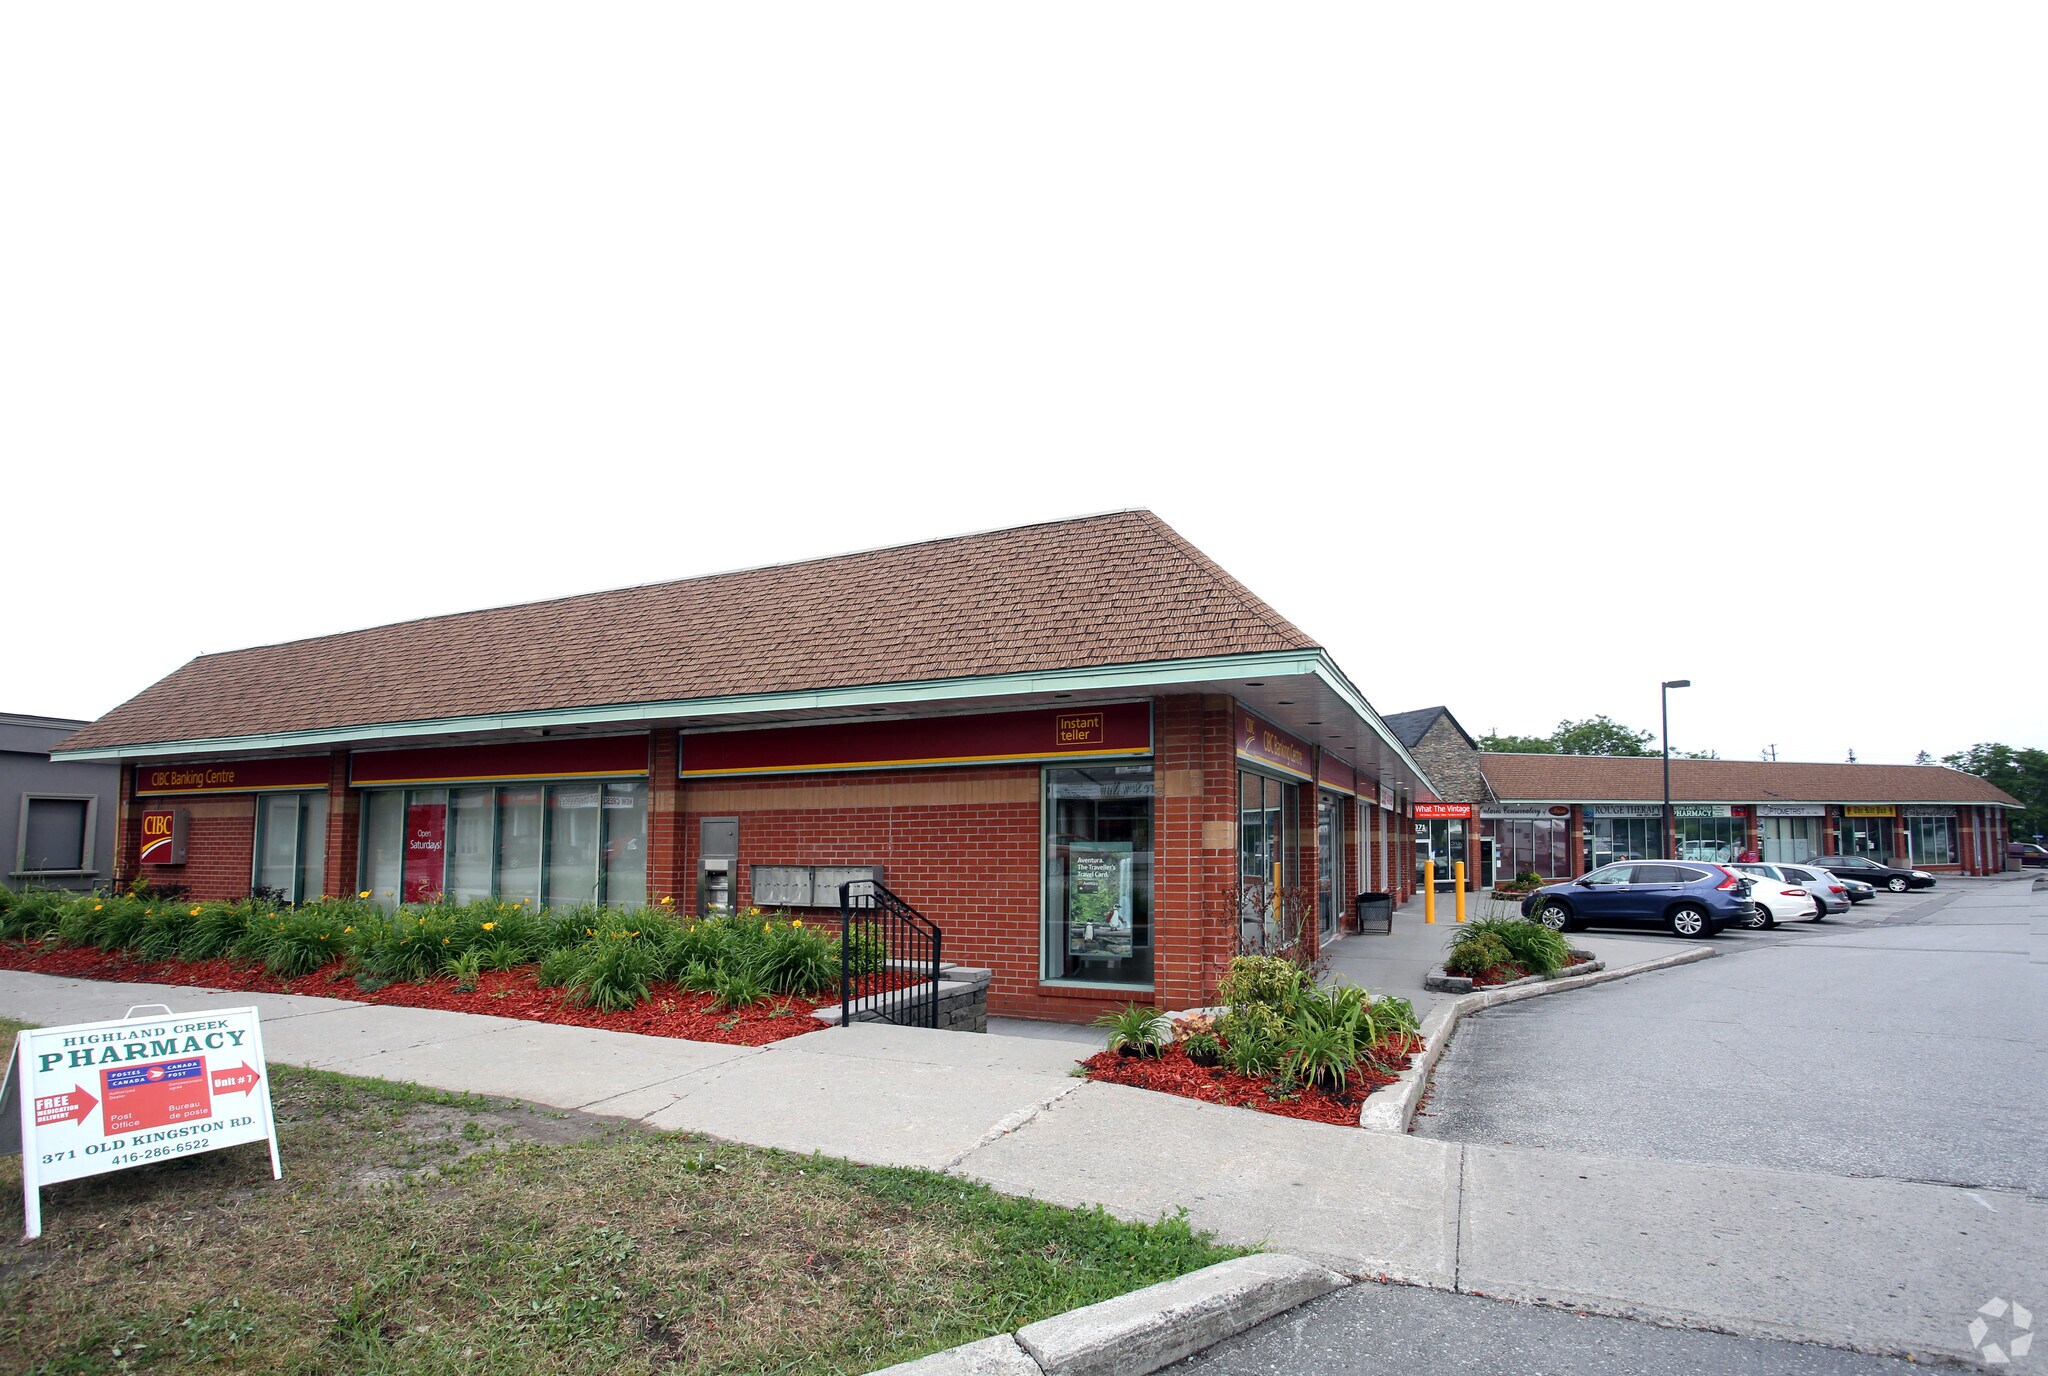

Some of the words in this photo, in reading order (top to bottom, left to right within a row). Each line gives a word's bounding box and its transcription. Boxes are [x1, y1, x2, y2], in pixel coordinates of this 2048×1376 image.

[1060, 716, 1099, 729] Instant
[1060, 729, 1090, 741] teller
[151, 771, 170, 787] CIBC
[171, 769, 204, 788] Banking
[205, 769, 235, 784] Centre
[1415, 805, 1432, 813] What
[1433, 805, 1446, 813] The
[1447, 804, 1471, 814] Vintage
[1595, 805, 1625, 815] ROUGE
[1627, 805, 1662, 815] THERAPY
[143, 815, 173, 835] CIBC
[417, 829, 432, 838] Open
[410, 840, 442, 851] Saturdays!
[63, 1026, 166, 1048] HIGHLAND
[173, 1019, 229, 1035] CREEK
[38, 1029, 246, 1073] PHARMACY
[167, 1061, 198, 1070] CANADA
[111, 1069, 141, 1078] POSTES
[112, 1077, 146, 1087] CANADA
[214, 1076, 236, 1088] Unit
[36, 1095, 69, 1111] FREE
[168, 1101, 200, 1112] Bureau
[37, 1104, 79, 1117] MEDICATION
[169, 1112, 181, 1120] de
[184, 1108, 209, 1118] poste
[37, 1111, 69, 1123] DELIVERY
[110, 1112, 133, 1122] Post
[111, 1119, 140, 1130] Office
[42, 1149, 77, 1165] 371
[85, 1138, 126, 1156] OLD
[132, 1120, 225, 1147] KINGSTON
[230, 1116, 256, 1129] RD.
[111, 1137, 210, 1166] 416-286-6522
